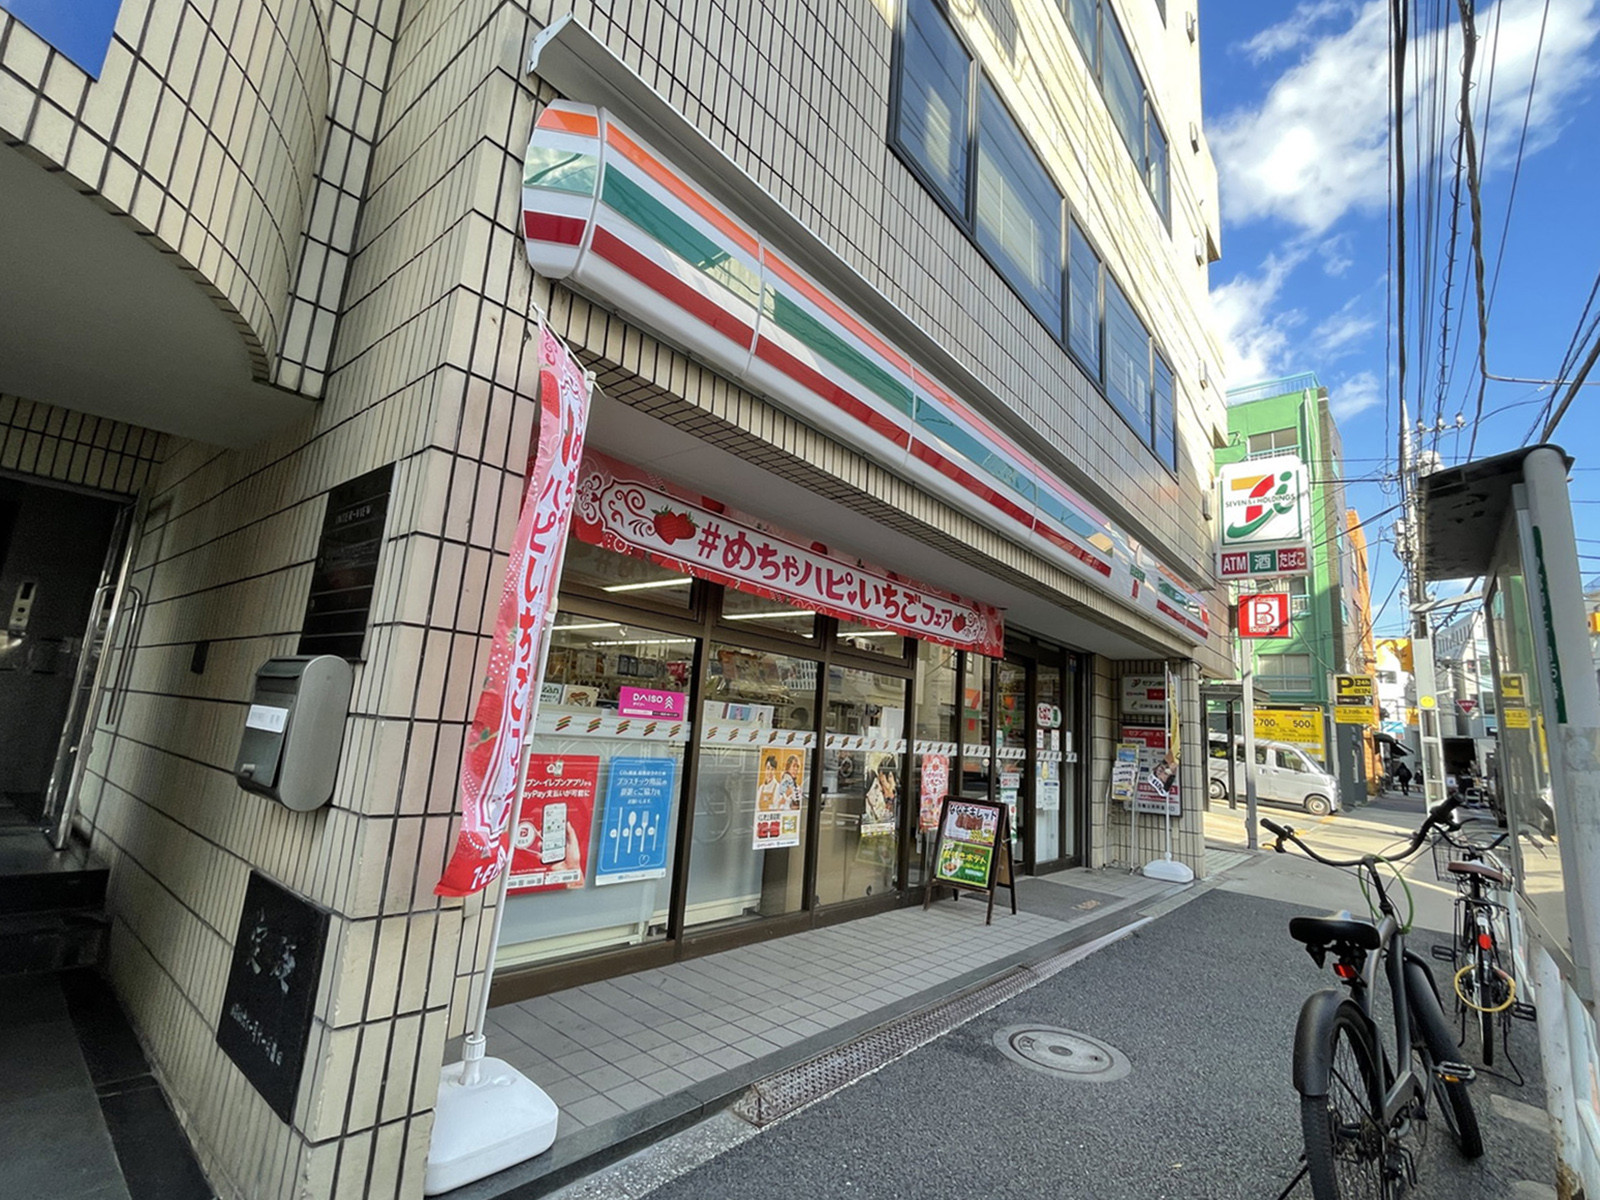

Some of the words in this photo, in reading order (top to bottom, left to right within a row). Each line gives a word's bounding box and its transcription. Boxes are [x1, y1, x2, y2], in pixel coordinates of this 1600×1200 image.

[1223, 556, 1247, 571] ATM
[1254, 554, 1271, 570] 酒
[1279, 552, 1306, 568] たばこ
[1336, 676, 1354, 694] P
[632, 693, 664, 704] DAISO
[522, 788, 591, 799] ayPay支払いが可能に
